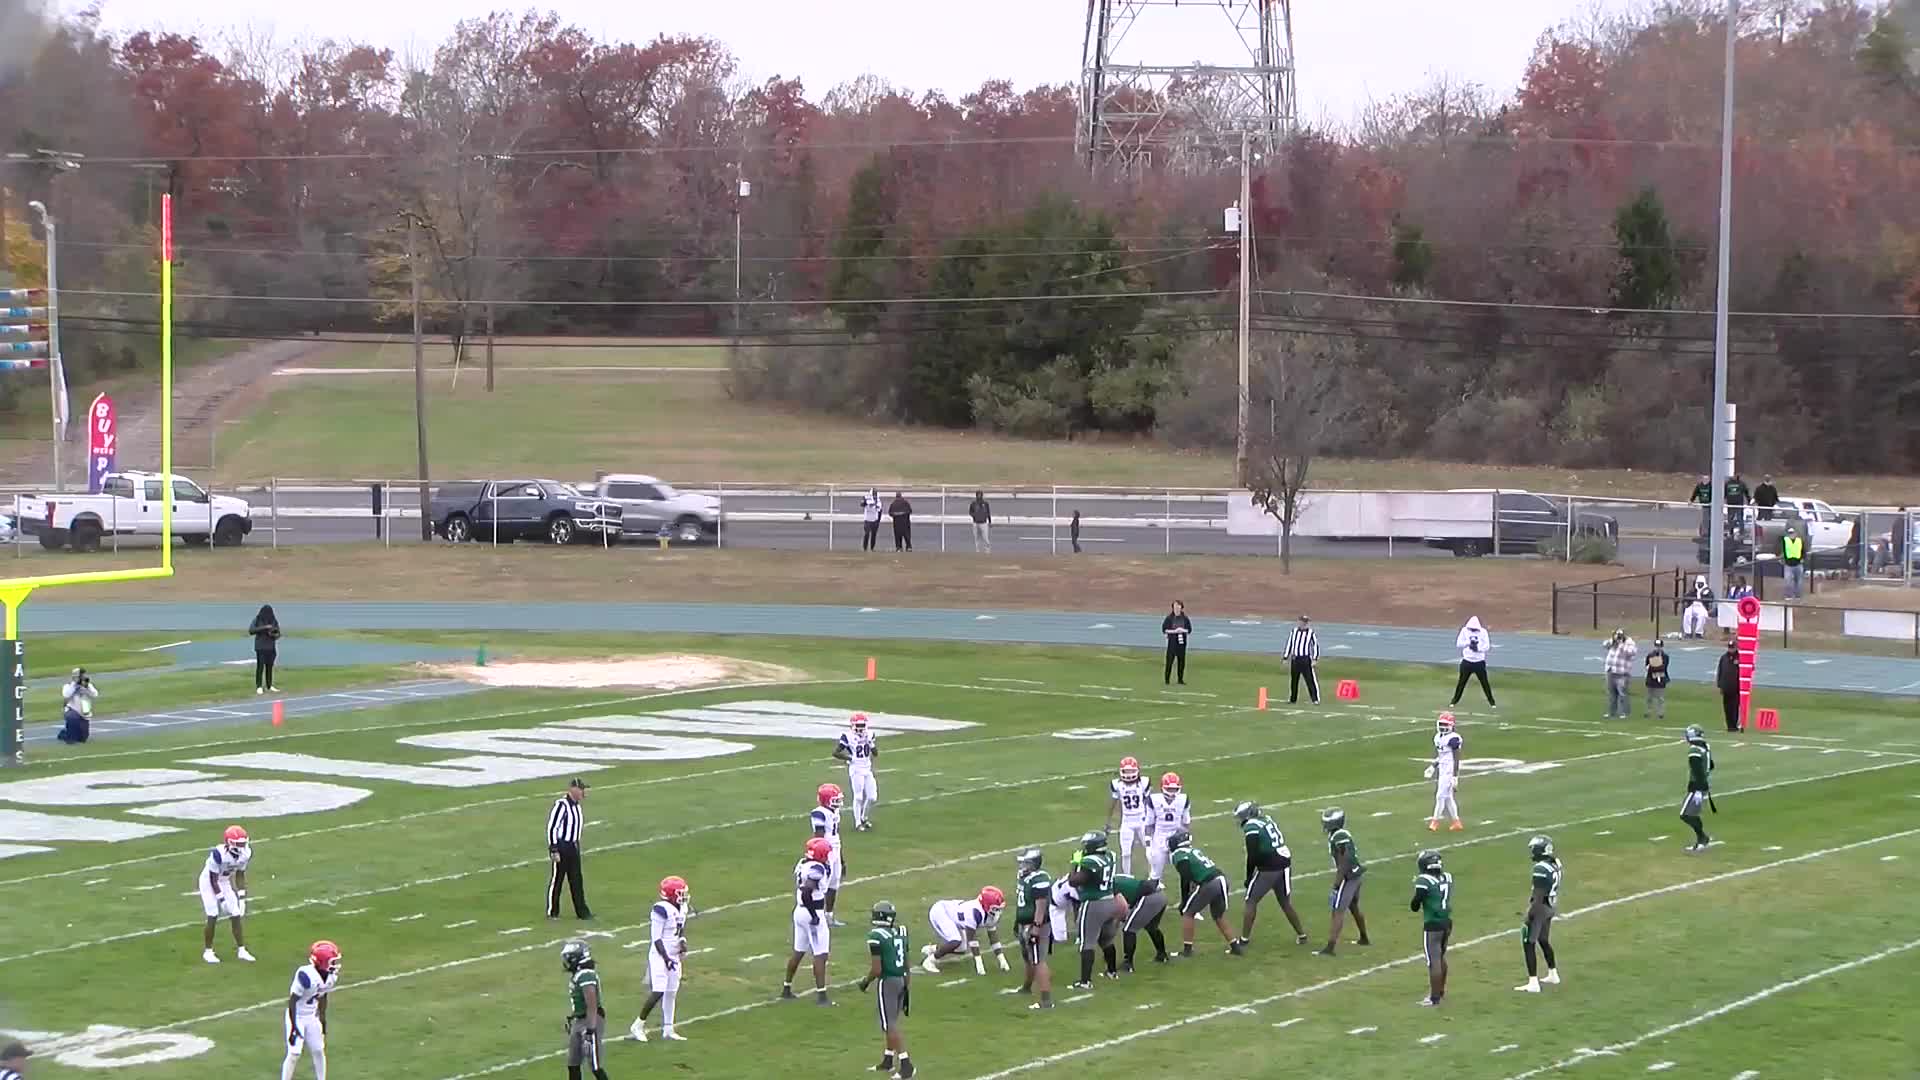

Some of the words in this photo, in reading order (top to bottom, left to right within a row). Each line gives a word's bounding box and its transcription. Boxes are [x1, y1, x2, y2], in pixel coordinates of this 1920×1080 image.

[96, 402, 114, 447] BUY
[14, 640, 24, 763] EAGLES
[856, 743, 870, 758] 20
[0, 700, 984, 858] SLOW
[1123, 795, 1140, 810] 23
[1439, 883, 1449, 910] 7
[894, 938, 904, 968] 3
